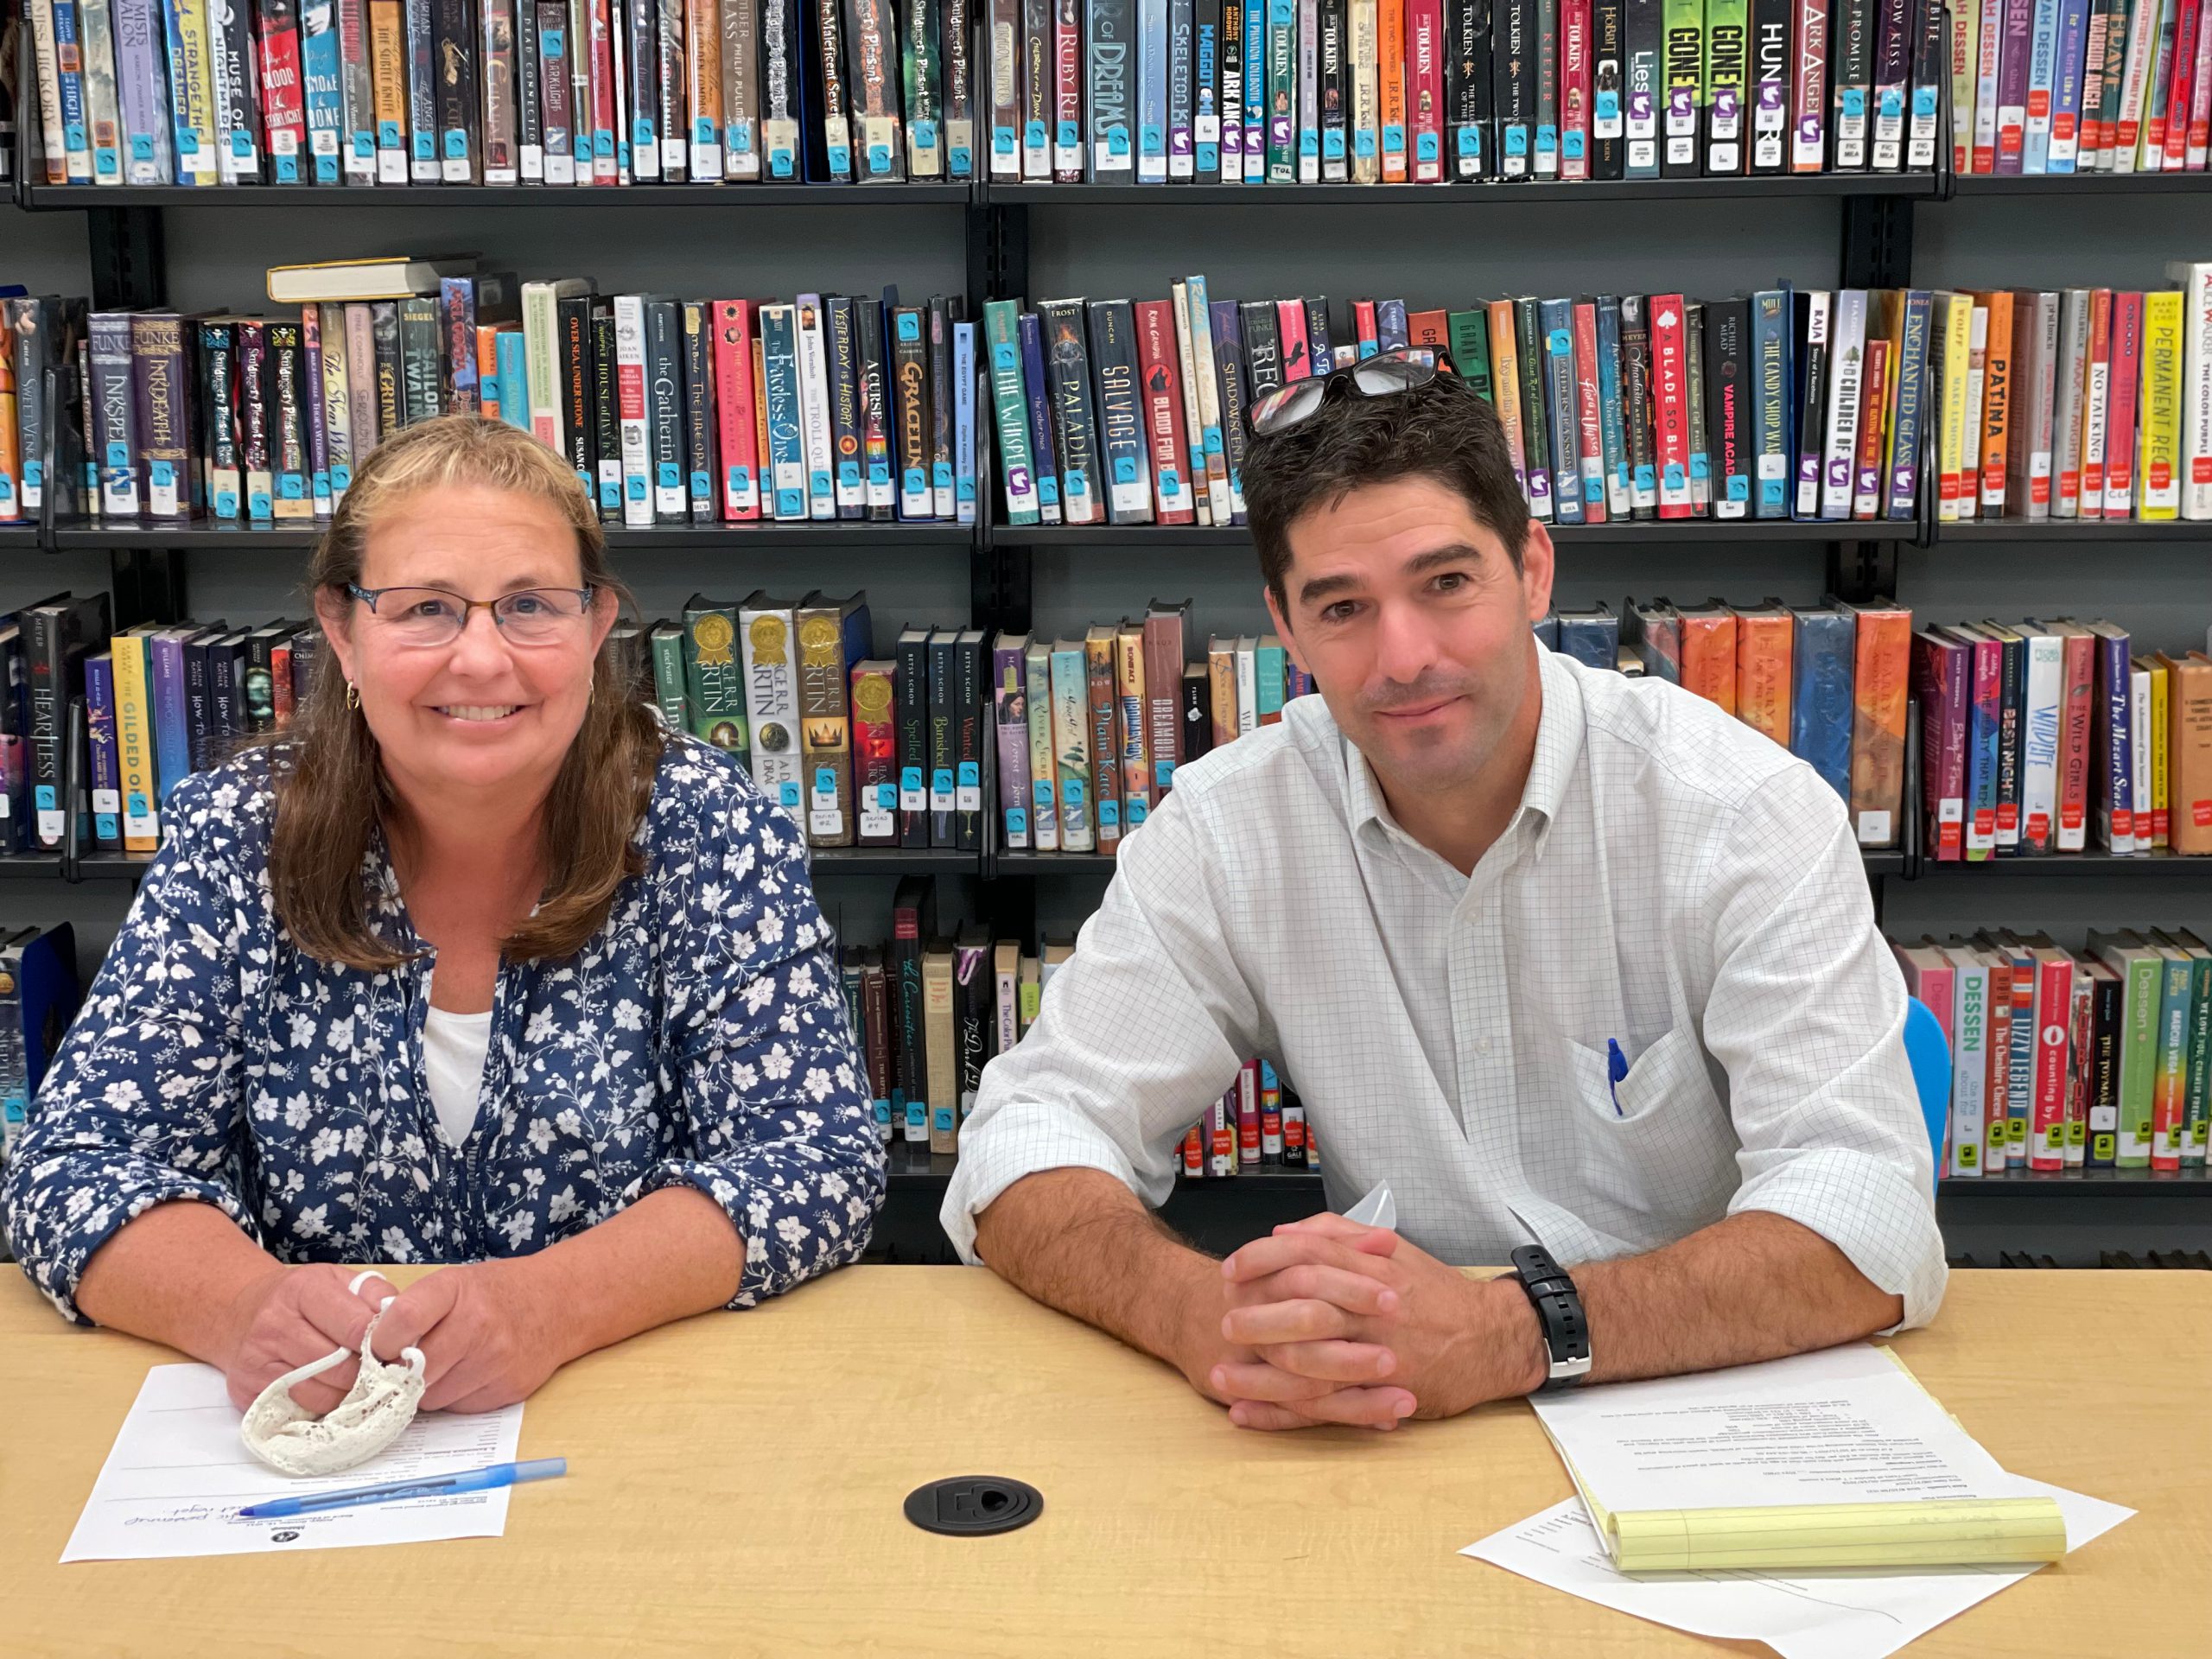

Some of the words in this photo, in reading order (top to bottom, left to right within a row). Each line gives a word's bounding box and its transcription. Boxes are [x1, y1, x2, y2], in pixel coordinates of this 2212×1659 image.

[524, 17, 532, 53] DEAD
[1275, 28, 1287, 76] TOLKIEN
[1463, 5, 1473, 55] TOLKIEN
[1510, 4, 1521, 54] TOLKIEN
[1849, 10, 1862, 80] PROMISE
[1889, 33, 1900, 67] KISS
[1954, 21, 1967, 75] DESSEN
[1982, 23, 1996, 78] DESSEN
[184, 29, 202, 103] STRANGE
[228, 51, 243, 98] MUSE
[734, 43, 744, 78] PHILIP
[1060, 34, 1077, 87] RUBY
[1174, 23, 1190, 104] SKELETON
[1199, 24, 1214, 89] MAGGOT
[1635, 51, 1654, 92] Lies
[1669, 28, 1700, 89] GONE
[1711, 25, 1743, 88] GONE
[2035, 31, 2050, 86] DESSEN
[525, 62, 536, 146] CONNECTIO
[1093, 43, 1127, 135] DREAMS
[1223, 71, 1240, 99] ARK
[308, 107, 340, 129] BONE
[133, 330, 180, 345] FUNKE
[404, 313, 434, 321] SIEGEL
[569, 316, 581, 342] OVER
[834, 307, 852, 369] YESTERDAY
[1106, 311, 1116, 344] DUNCAN
[1728, 316, 1737, 357] RICHELLE
[1813, 309, 1824, 339] RAJA
[92, 334, 130, 351] FUNKE
[659, 357, 672, 377] the
[1902, 314, 1923, 415] ENCHANTED
[406, 350, 423, 416] TWAIN
[422, 347, 440, 417] SAILOR
[572, 365, 583, 397] UNDER
[868, 373, 883, 420] CURSE
[996, 369, 1020, 399] THE
[1663, 347, 1676, 404] BLADE
[1764, 362, 1780, 395] CANDY
[2094, 368, 2105, 391] NO
[2152, 327, 2174, 427] PERMANENT
[2202, 363, 2210, 381] THE
[148, 359, 171, 444] INKDEATH
[574, 397, 584, 429] STONE
[839, 382, 854, 429] HISTORY
[1103, 365, 1136, 450] SALVAGE
[1154, 397, 1172, 431] BLOOD
[1667, 409, 1677, 429] SO
[1724, 385, 1734, 440] VAMPIRE
[1764, 398, 1781, 430] SHOP
[1988, 359, 2006, 438] PATINA
[2201, 383, 2210, 415] COLOR
[1898, 418, 1915, 467] GLASS
[2090, 394, 2103, 458] TALKING
[2199, 416, 2209, 454] PURPLE
[2003, 709, 2016, 747] BEST
[2111, 694, 2126, 721] The
[29, 688, 59, 779] HEARTLESS
[124, 702, 139, 768] GILDED
[933, 716, 950, 766] Banished
[2112, 722, 2126, 773] Mozart
[2001, 750, 2014, 799] NIGHT
[1963, 976, 1982, 1052] DESSEN
[2136, 968, 2153, 1029] Dessen
[2011, 1018, 2031, 1052] LIZZY
[2008, 1058, 2031, 1108] LEGEND
[2044, 1049, 2057, 1103] counting
[2098, 1060, 2111, 1107] TOYMAK
